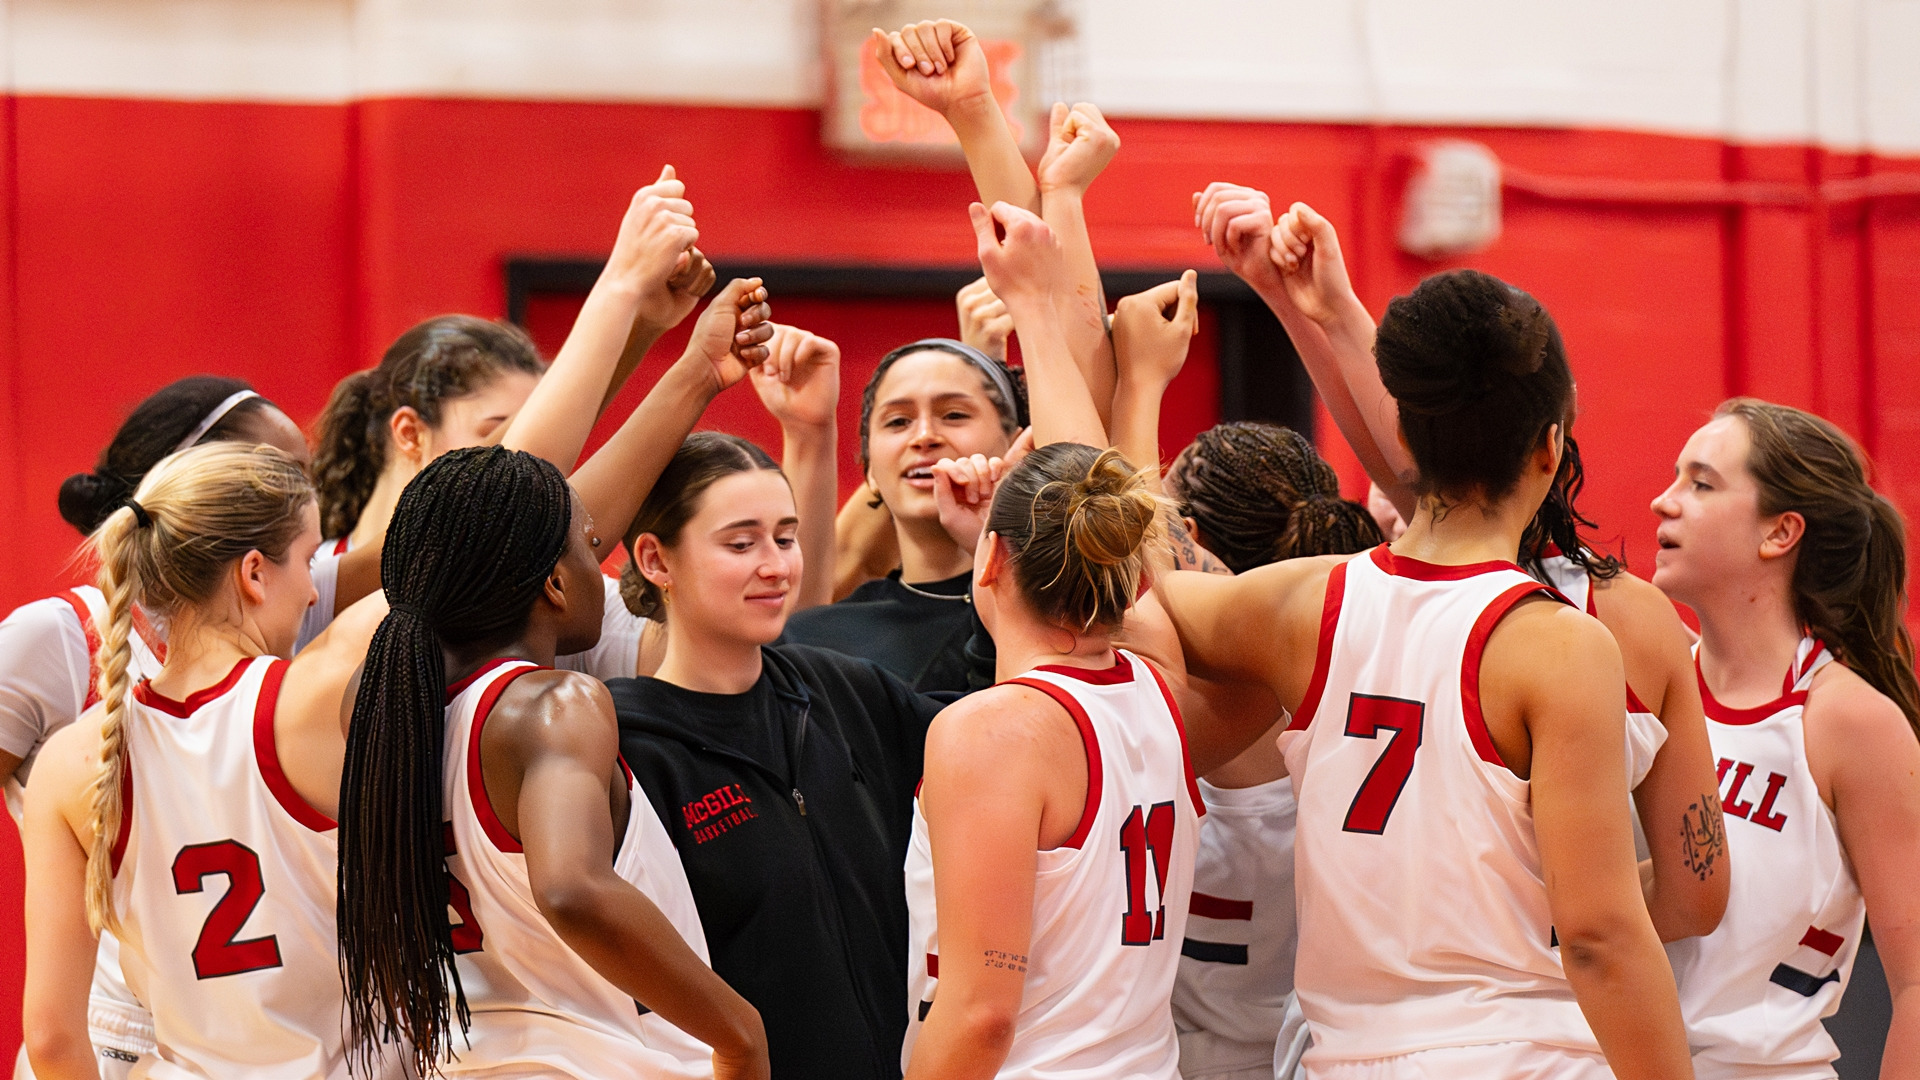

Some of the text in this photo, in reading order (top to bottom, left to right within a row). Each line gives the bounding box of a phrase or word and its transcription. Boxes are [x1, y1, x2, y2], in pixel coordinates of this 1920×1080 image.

[1342, 692, 1425, 835] 7
[171, 838, 283, 980] 2
[1119, 800, 1175, 946] 11
